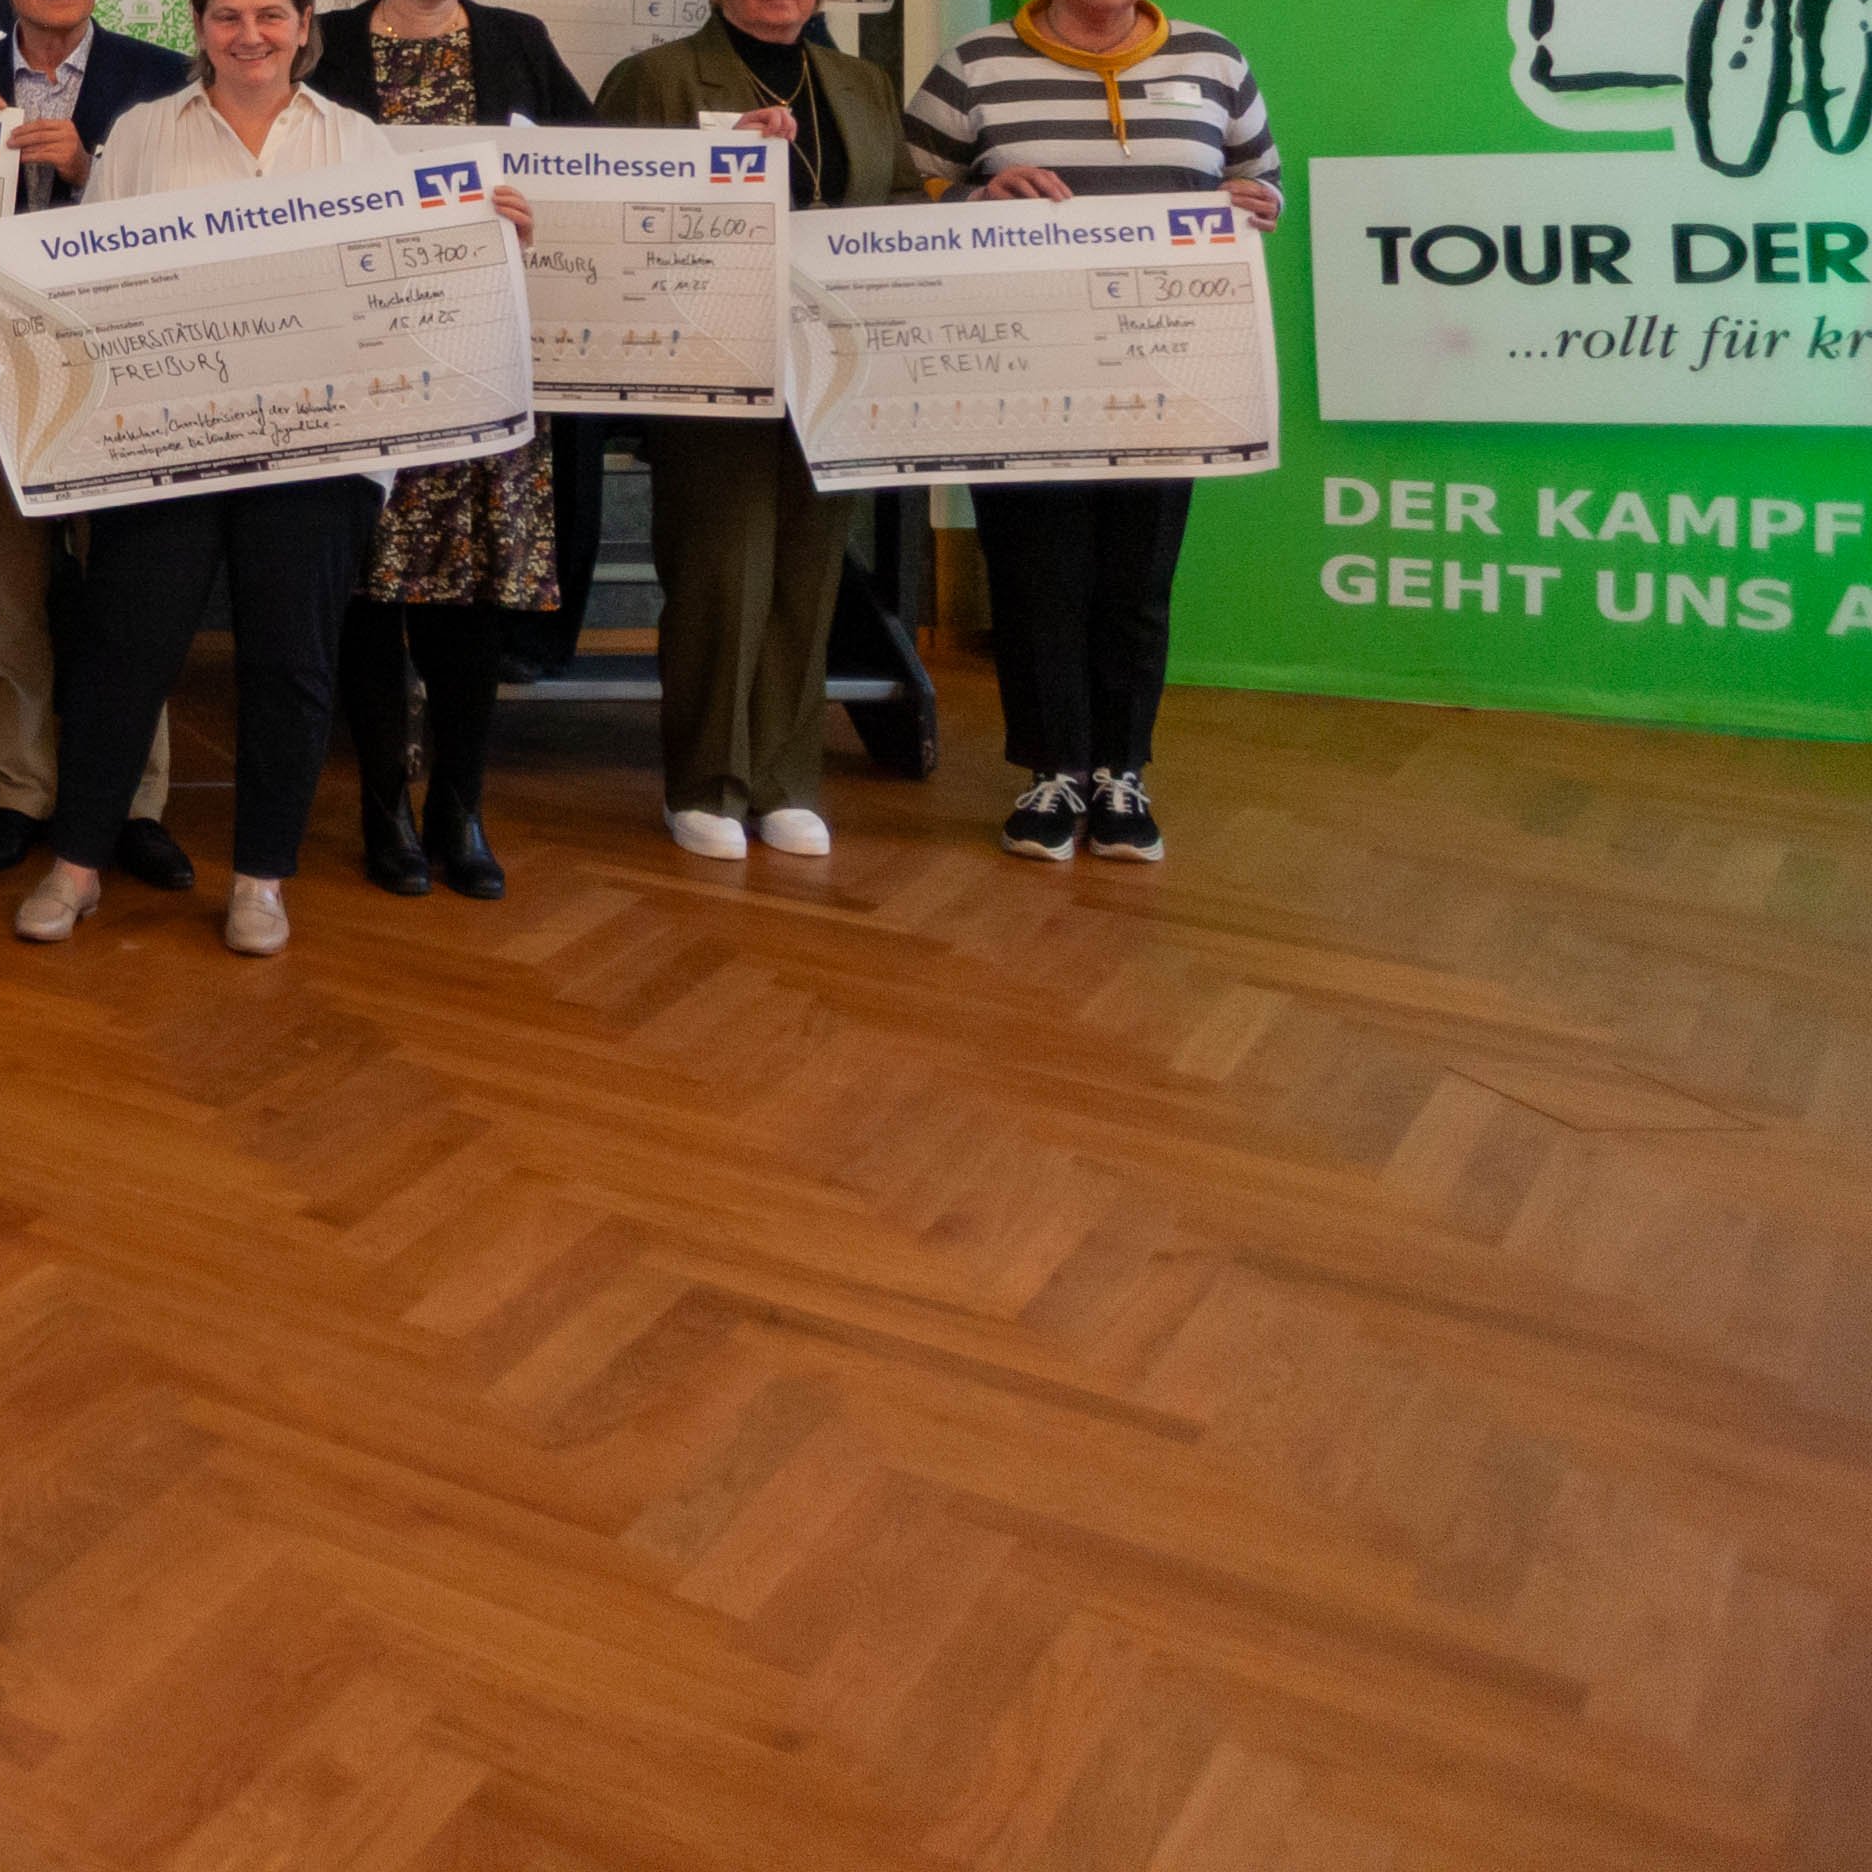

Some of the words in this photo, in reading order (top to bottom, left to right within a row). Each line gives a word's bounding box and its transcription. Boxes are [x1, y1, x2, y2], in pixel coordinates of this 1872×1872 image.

[648, 1, 661, 18] €
[502, 152, 696, 179] Mittelhessen
[40, 216, 197, 262] Volksbank
[204, 186, 405, 236] Mittelhessen
[641, 215, 656, 234] €
[828, 225, 962, 257] Volksbank
[971, 222, 1155, 249] Mittelhessen
[359, 253, 377, 273] €
[1365, 223, 1633, 287] TOUR
[1671, 221, 1872, 286] DER
[1106, 282, 1121, 299] €
[865, 327, 935, 351] HENRI
[940, 321, 1030, 348] THALER
[1689, 316, 1791, 373] für
[109, 350, 230, 387] FREIBURG
[904, 353, 1001, 384] VEREIN
[1323, 476, 1504, 536] DER
[1537, 487, 1866, 557] KAMPF
[1319, 554, 1562, 616] GEHT
[1595, 570, 1795, 632] UNS
